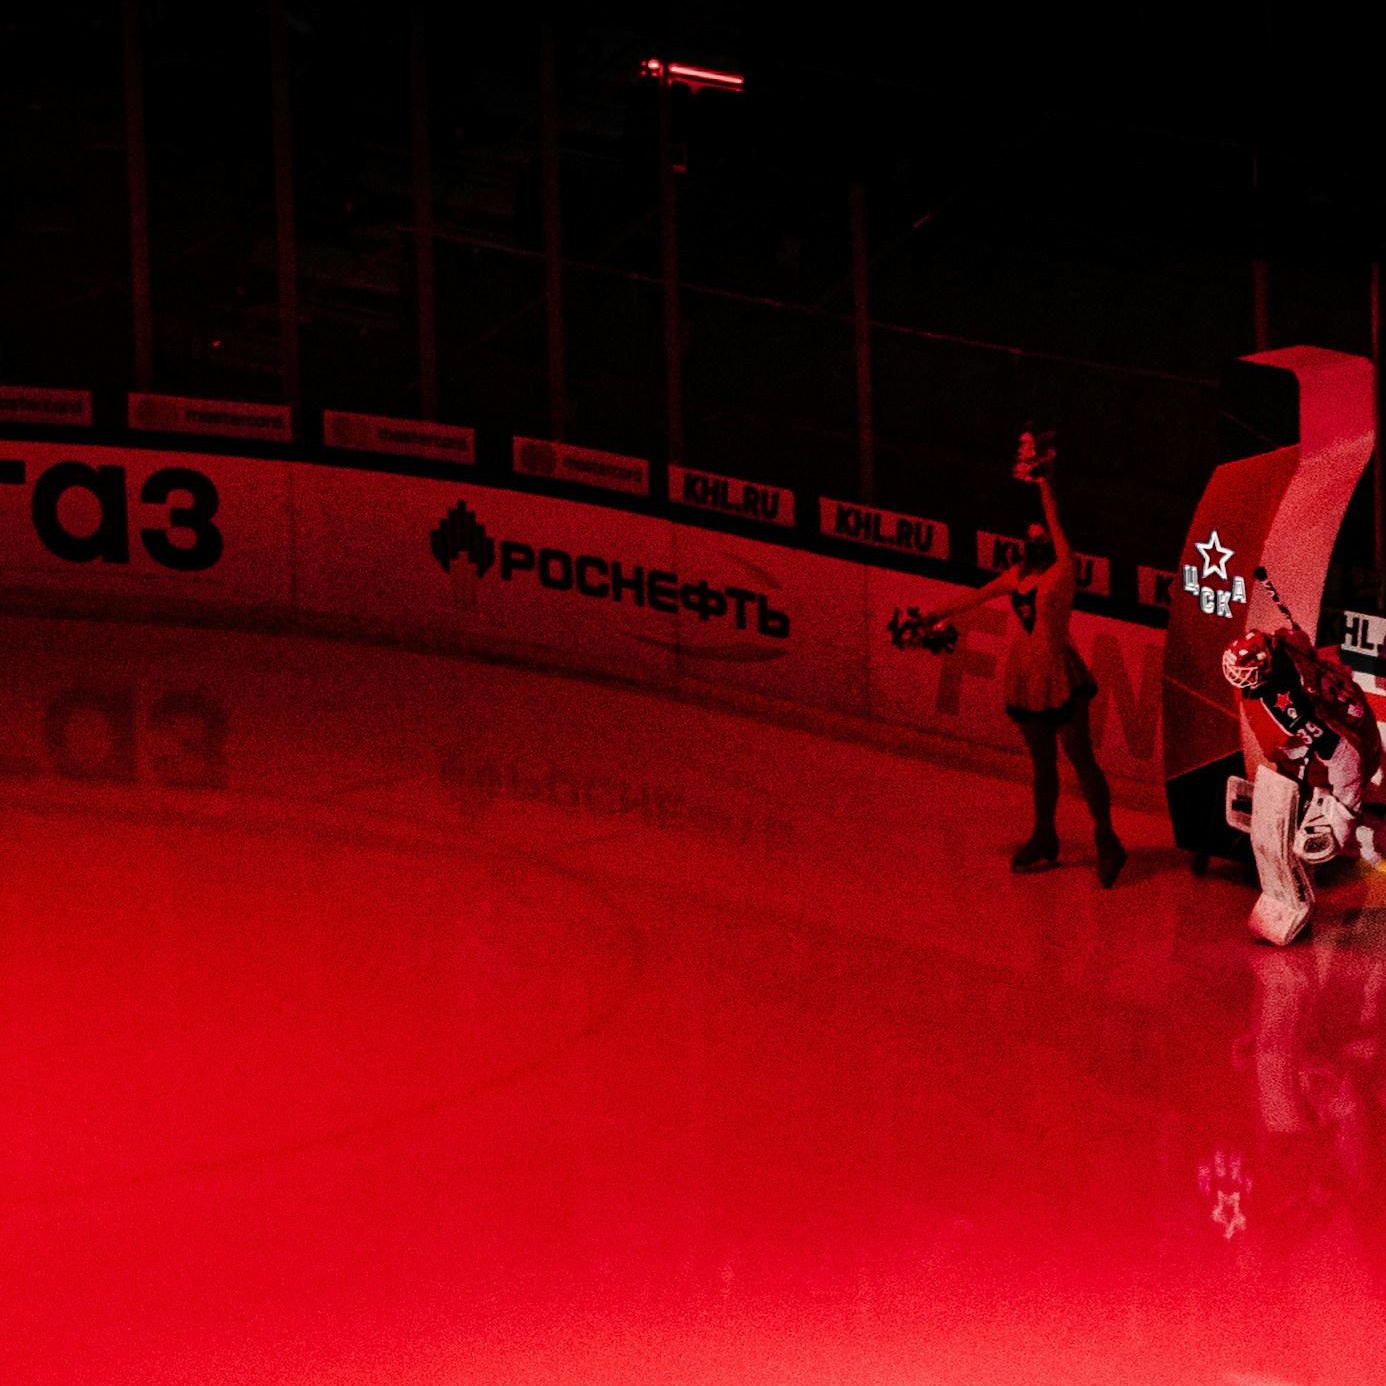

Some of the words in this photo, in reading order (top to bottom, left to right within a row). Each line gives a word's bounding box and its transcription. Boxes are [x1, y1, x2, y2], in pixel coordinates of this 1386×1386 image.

[683, 471, 780, 520] KHL.RU
[835, 505, 934, 553] KHL.RU
[500, 541, 791, 639] РОСНЕФТЬ
[1183, 563, 1248, 619] ЦСКА
[1296, 721, 1324, 745] 39
